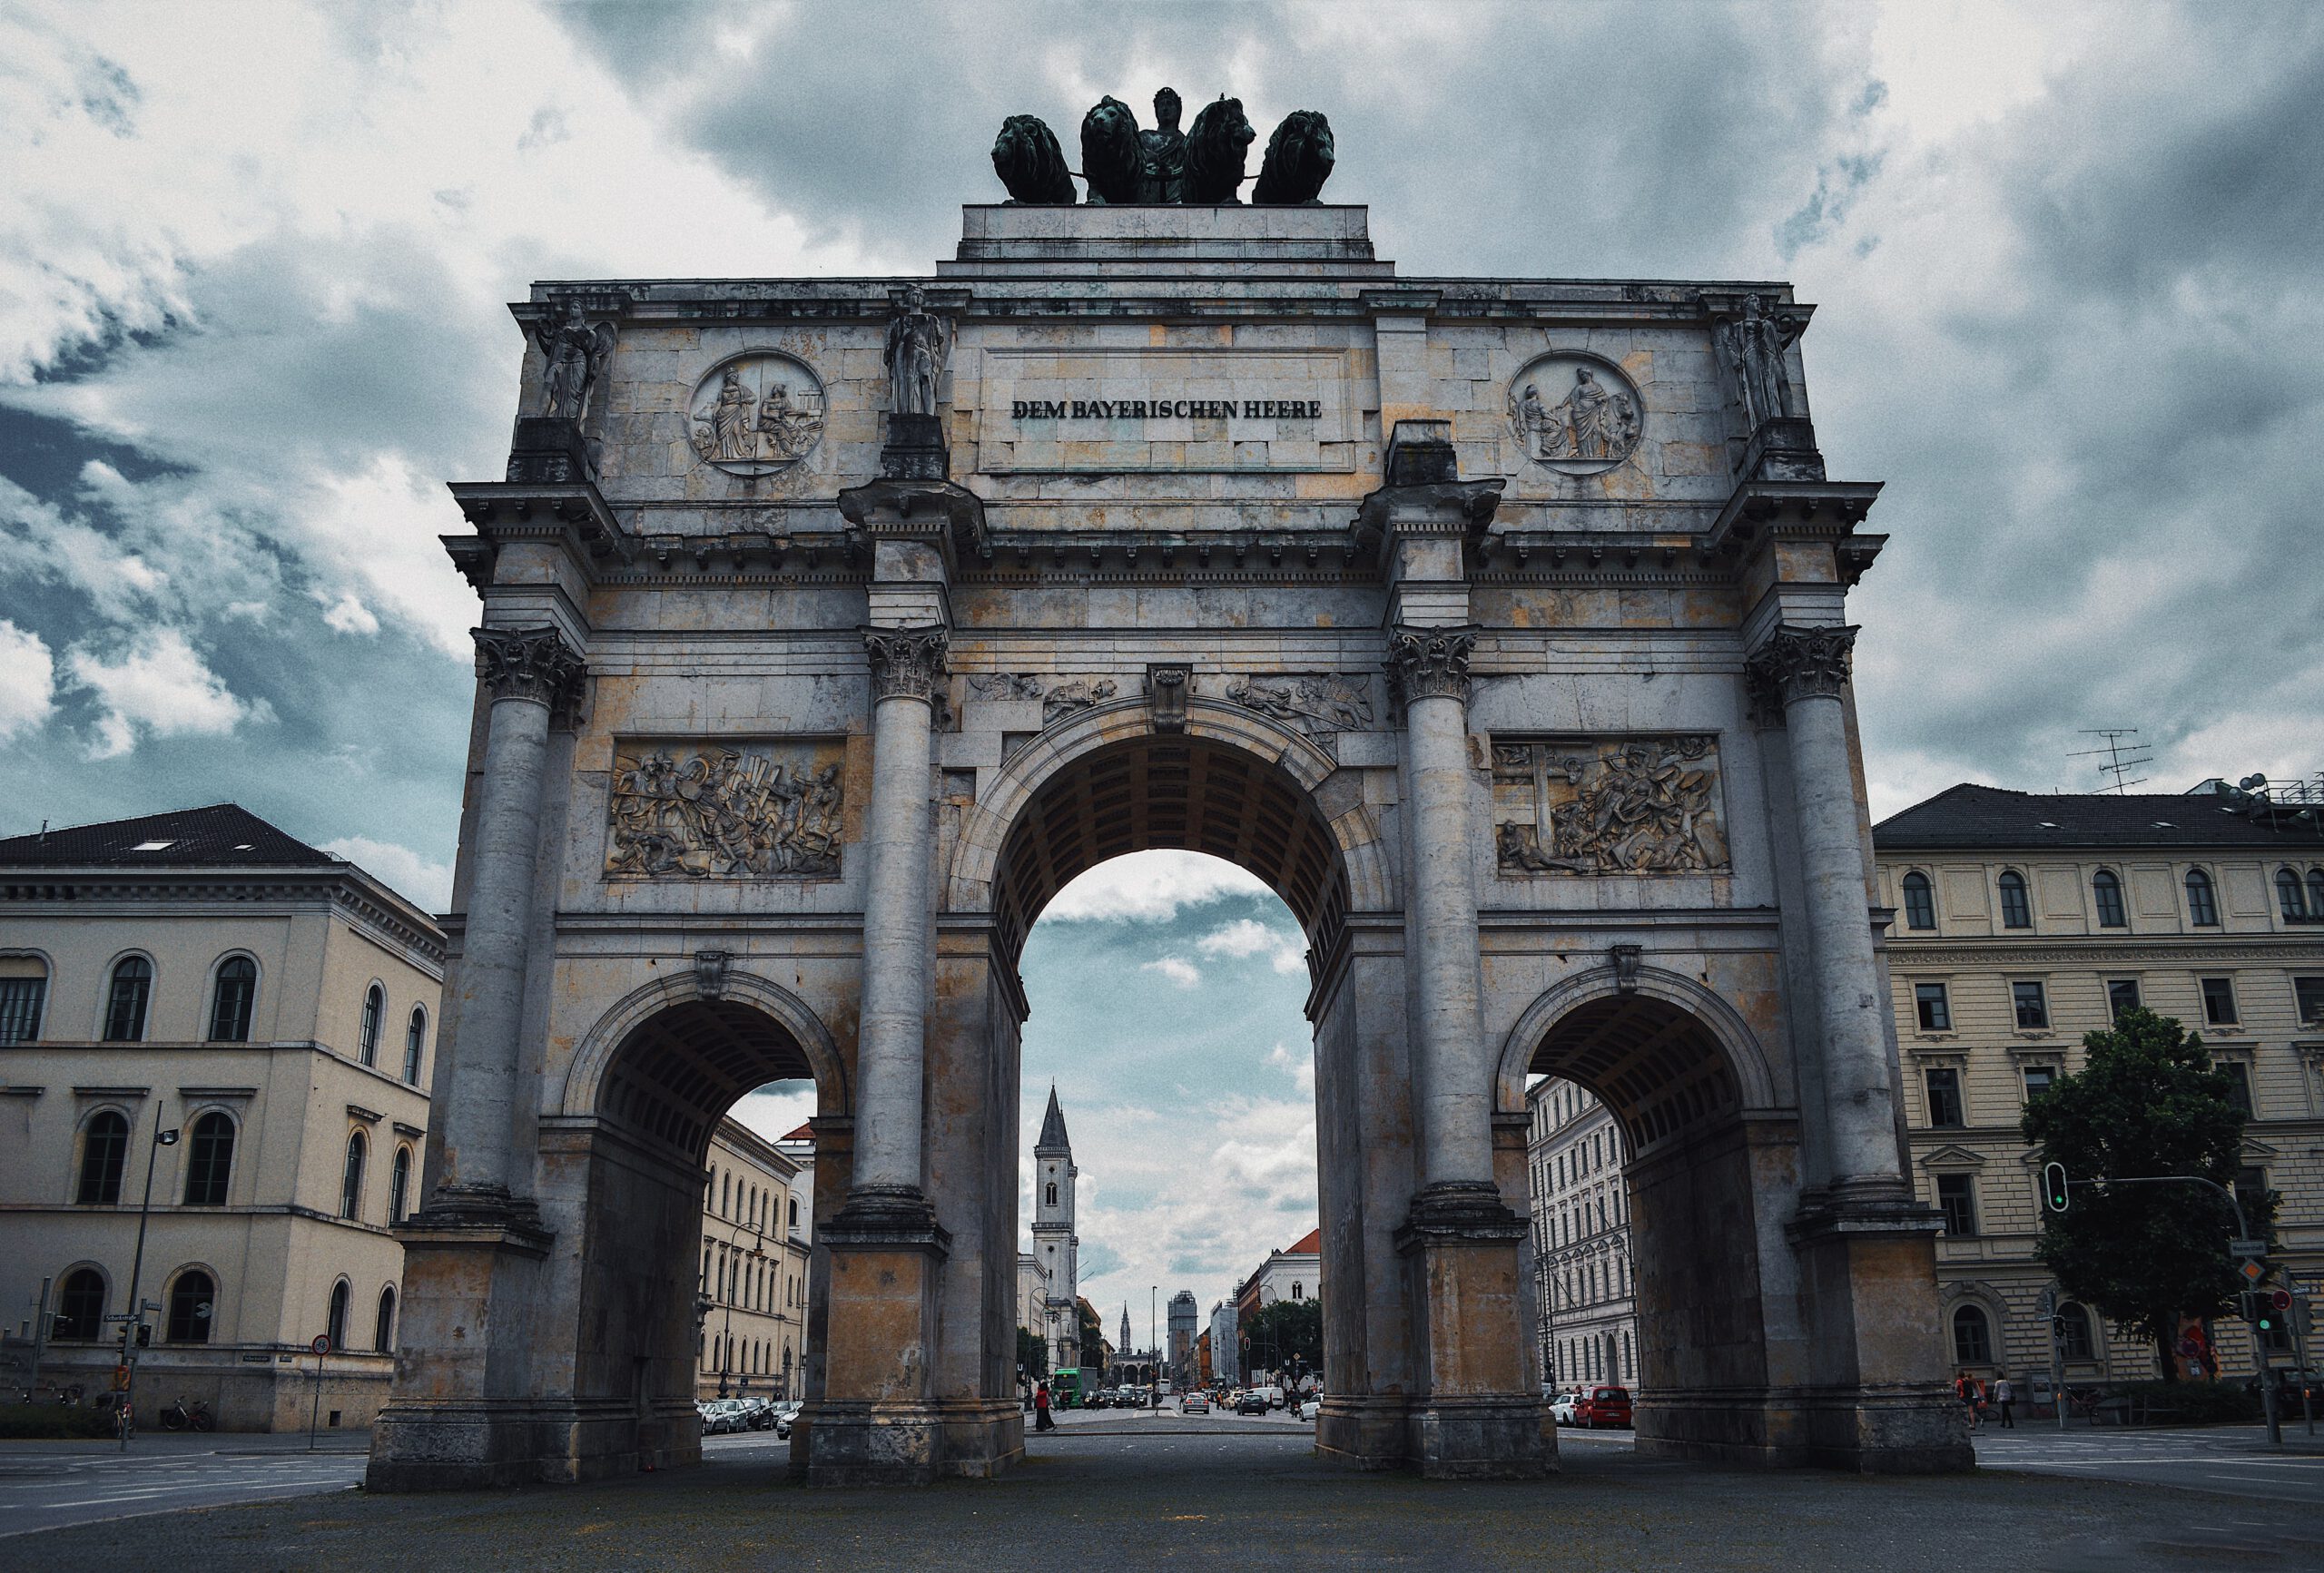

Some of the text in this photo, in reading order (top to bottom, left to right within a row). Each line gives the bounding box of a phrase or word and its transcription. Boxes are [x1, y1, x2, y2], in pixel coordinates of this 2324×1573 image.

[1011, 400, 1323, 419] DEM BAYERISCHEN HEERE
[1017, 1363, 1023, 1371] U
